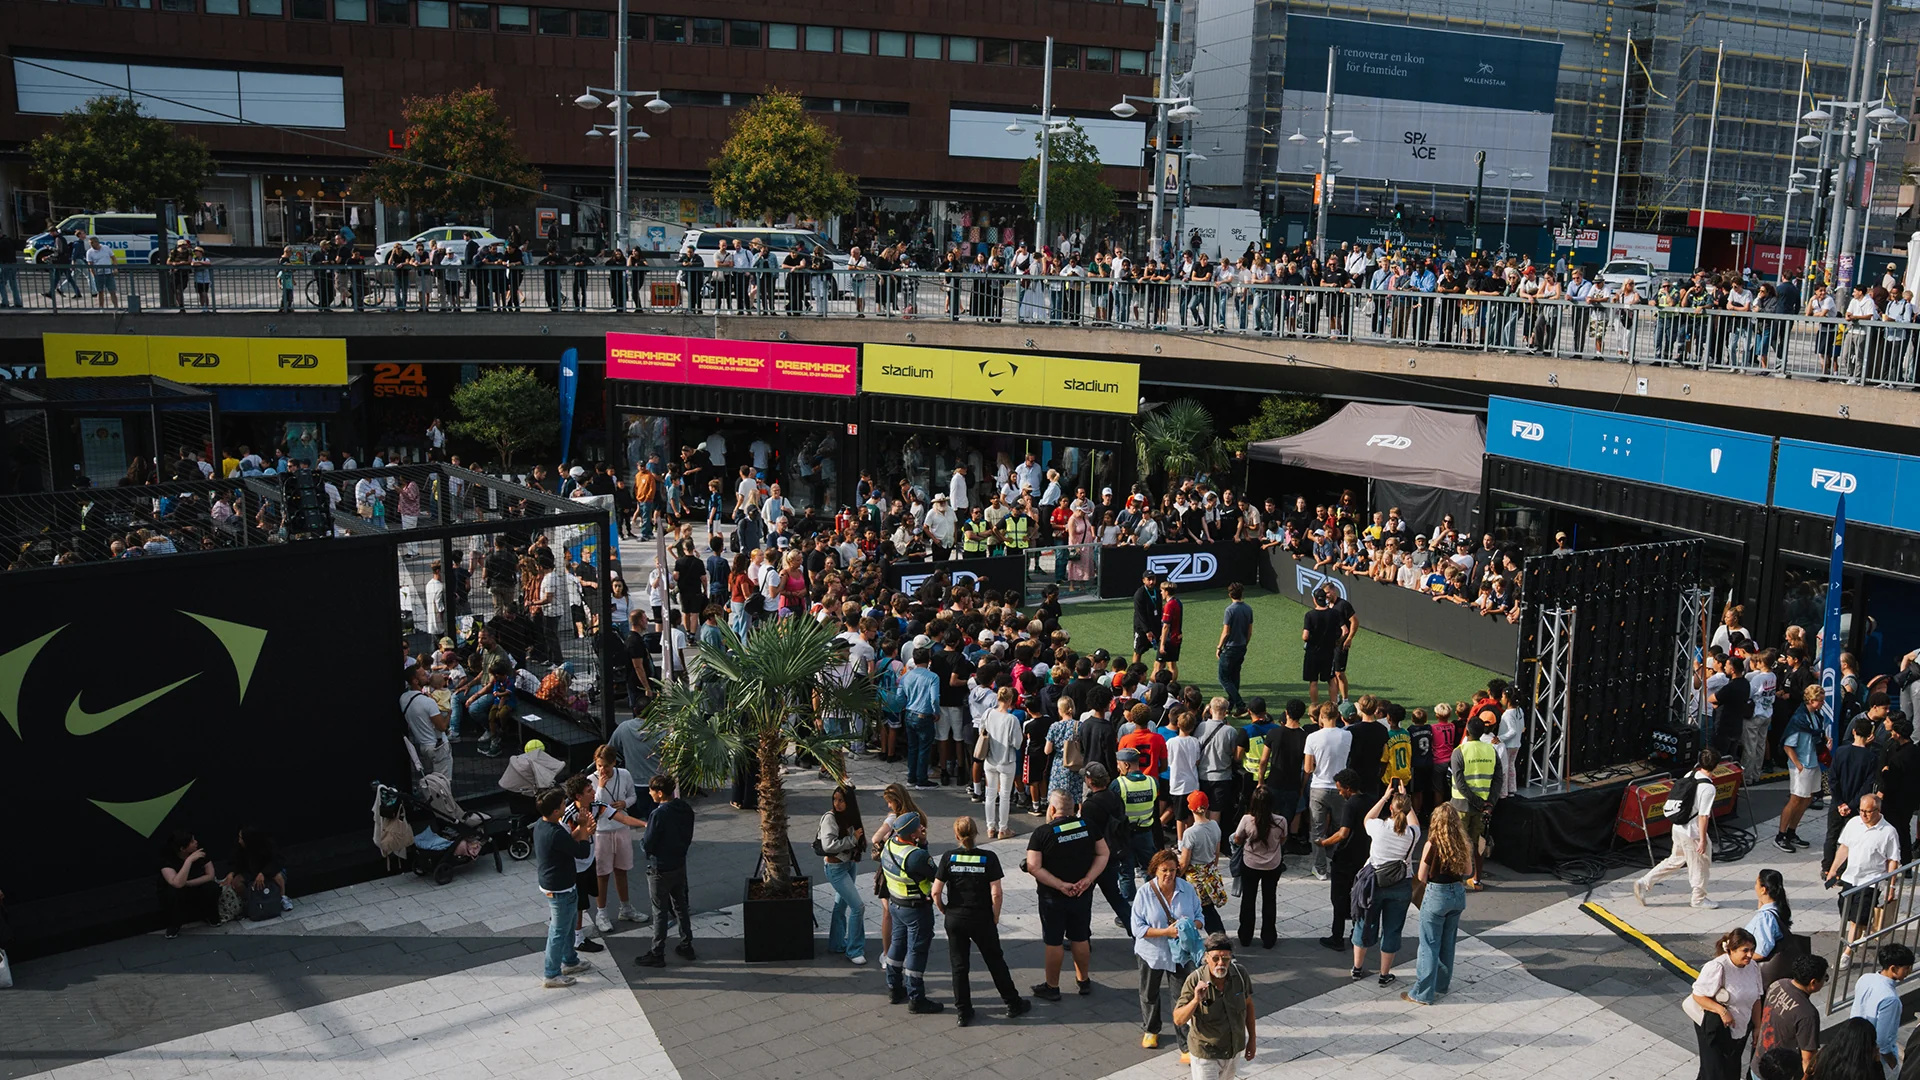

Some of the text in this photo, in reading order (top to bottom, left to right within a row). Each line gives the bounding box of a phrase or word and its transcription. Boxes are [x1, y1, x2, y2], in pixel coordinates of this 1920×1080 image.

[1344, 48, 1388, 61] renoverar
[1391, 53, 1402, 62] en
[1404, 53, 1425, 64] ikon
[1346, 61, 1408, 77] för framtiden
[1463, 76, 1506, 86] WALLENSTAM
[75, 351, 119, 366] FZD
[178, 352, 220, 368] FZD
[278, 354, 319, 369] FZD
[611, 348, 682, 362] DREAMHACK
[692, 354, 765, 368] DREAMHACK
[373, 363, 427, 384] 24
[775, 360, 851, 373] DREAMHACK
[881, 364, 934, 379] stadium
[374, 385, 428, 398] SEVEN
[1063, 378, 1119, 393] stadium
[1511, 419, 1545, 442] FZD
[1366, 434, 1412, 450] FZD
[1811, 467, 1857, 494] FZD
[1146, 552, 1218, 584] FZD
[1442, 729, 1453, 745] 11
[1418, 737, 1430, 756] 9
[1395, 746, 1407, 770] 10
[1127, 790, 1152, 798] ORDNINGS
